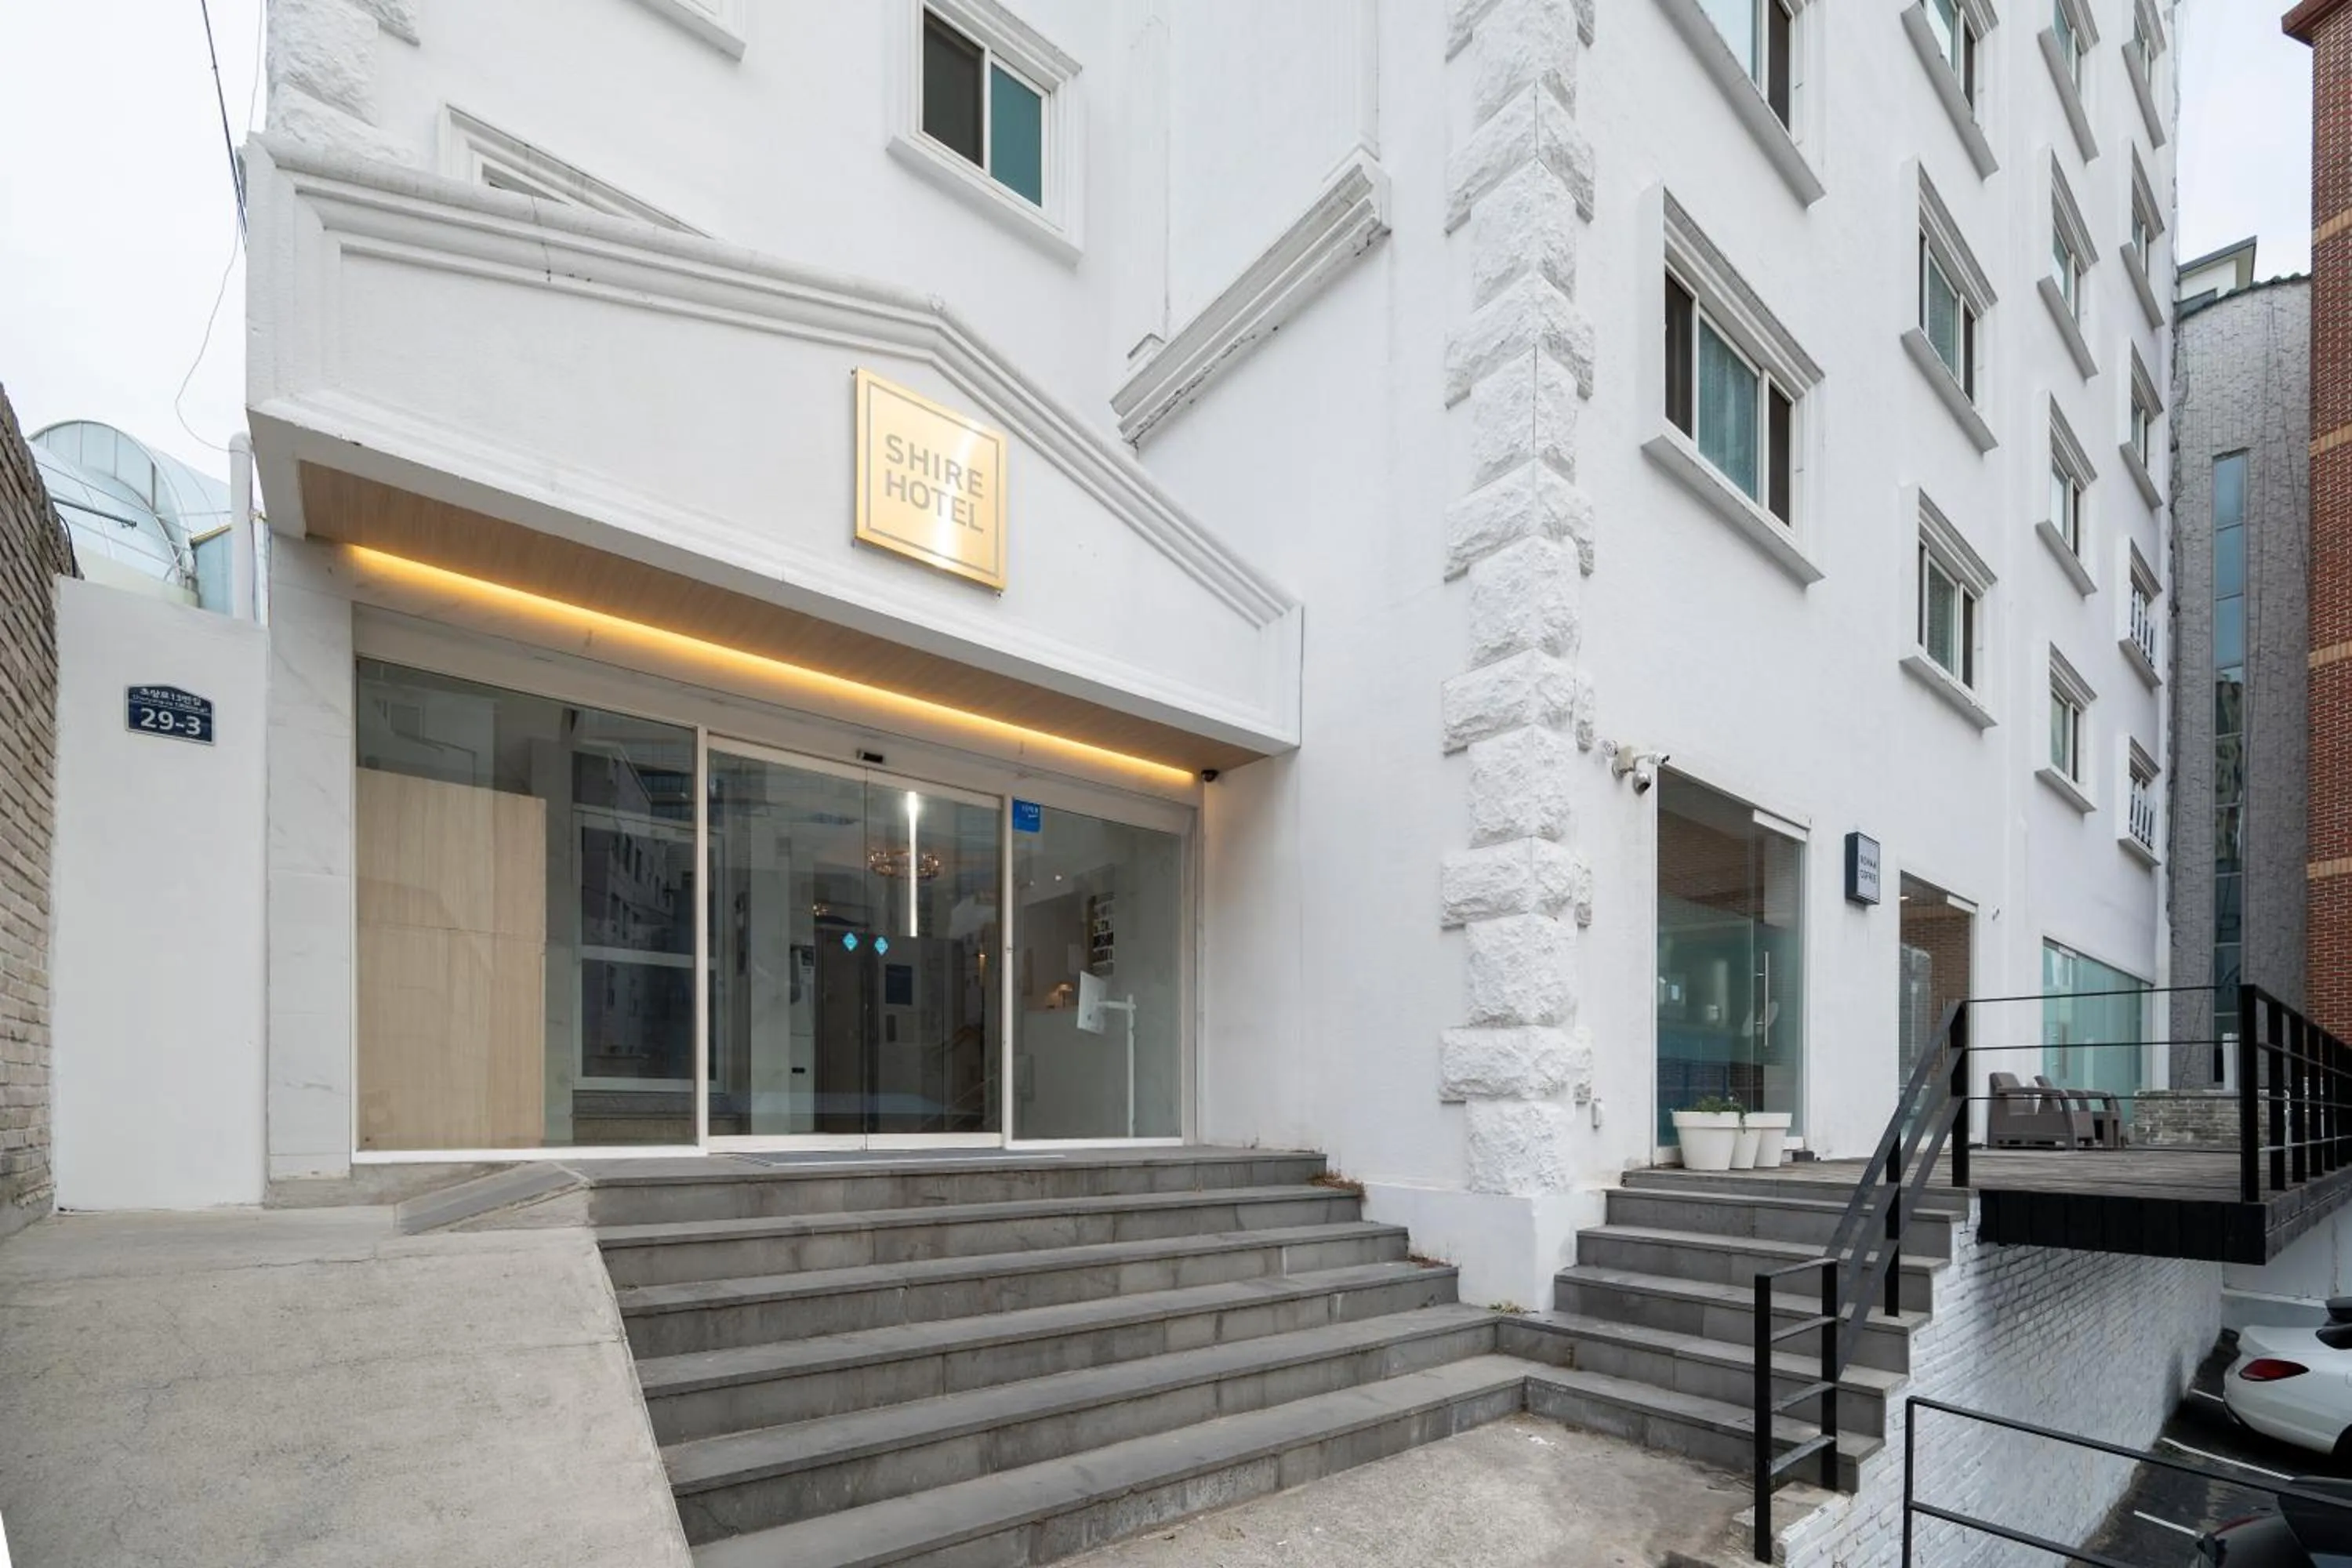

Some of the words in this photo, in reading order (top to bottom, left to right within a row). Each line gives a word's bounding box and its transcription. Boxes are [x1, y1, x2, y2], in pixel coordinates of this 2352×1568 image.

[885, 434, 984, 499] SHIRE
[885, 469, 984, 534] HOTEL
[140, 707, 201, 735] 29-3
